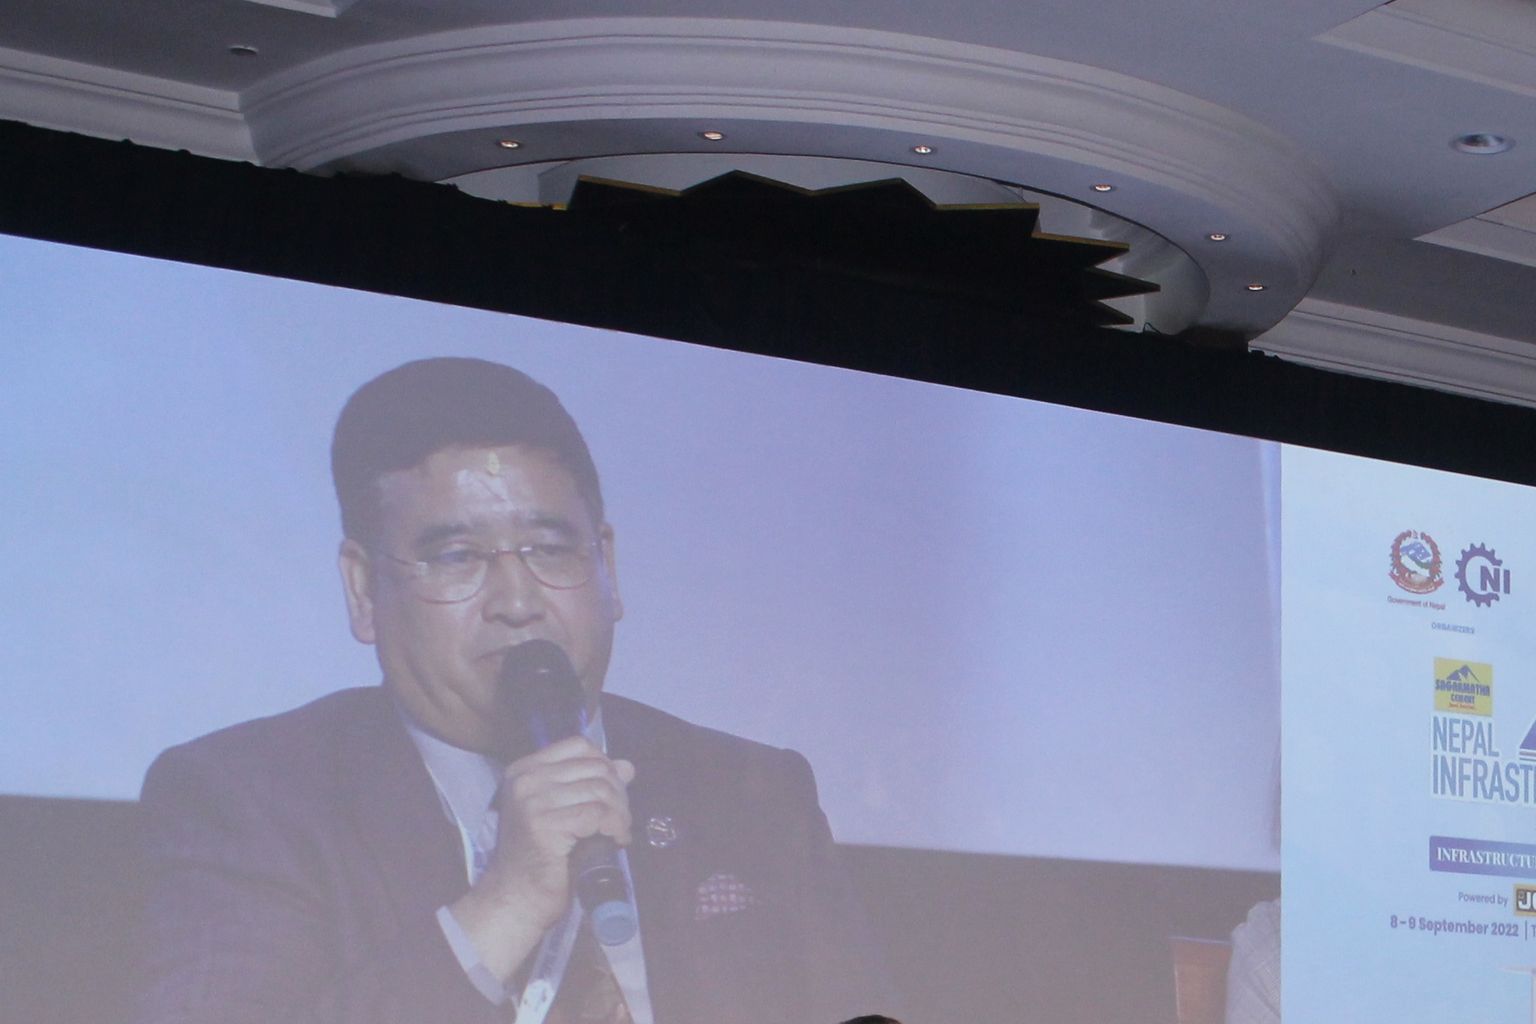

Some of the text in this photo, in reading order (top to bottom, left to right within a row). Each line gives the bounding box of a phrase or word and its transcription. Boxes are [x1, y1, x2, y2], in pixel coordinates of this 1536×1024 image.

[1387, 595, 1421, 607] Government
[1429, 601, 1446, 610] Nepal
[1435, 679, 1490, 697] SAGARMATHA
[1433, 716, 1499, 757] NEPAL
[1458, 892, 1508, 907] Powered by
[1419, 917, 1488, 935] September
[1491, 922, 1519, 937] 2022
